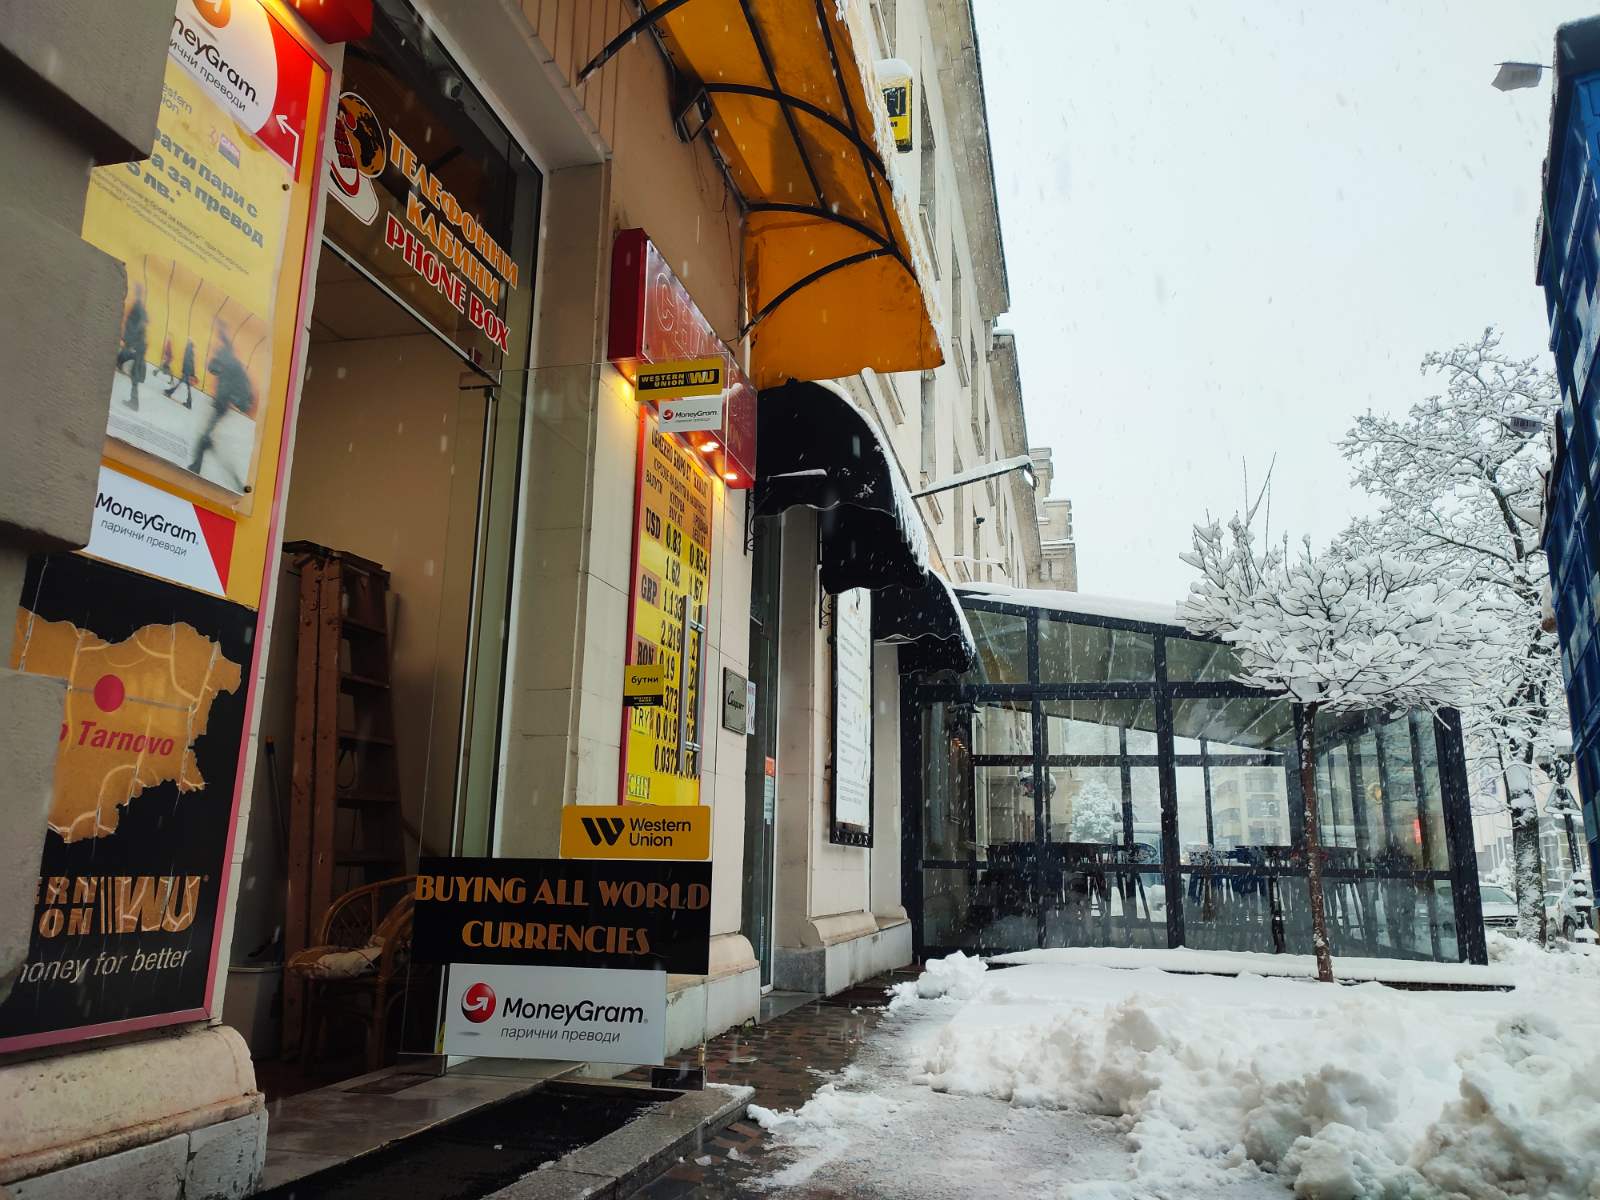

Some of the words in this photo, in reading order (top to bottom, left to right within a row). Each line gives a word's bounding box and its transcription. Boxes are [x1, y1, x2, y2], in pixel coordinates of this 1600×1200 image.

[170, 38, 198, 68] ични
[200, 67, 246, 112] преводи
[174, 16, 257, 102] neyGram
[161, 83, 192, 114] estern
[198, 164, 244, 208] пари
[168, 166, 191, 192] за
[195, 186, 263, 248] превод
[389, 129, 519, 289] ТЕЛЕФОННИ
[406, 190, 499, 306] КАБИНИ
[385, 212, 466, 314] PHONE
[469, 292, 511, 355] BOX
[641, 373, 684, 383] WESTERN
[654, 379, 684, 388] UNION
[675, 410, 717, 418] MoneyGram
[96, 493, 196, 544] MoneyGram
[646, 507, 661, 539] USD
[666, 523, 681, 557] 0.83
[101, 519, 144, 541] парични
[146, 535, 187, 556] преводи
[641, 573, 657, 605] GBP
[637, 641, 654, 665] RON
[631, 675, 659, 686] бутни
[632, 705, 649, 726] TRY
[78, 721, 175, 756] Tarnovo
[629, 833, 672, 847] Union
[630, 817, 691, 832] Western
[415, 875, 526, 904] BUYING
[532, 879, 589, 906] ALL
[599, 880, 709, 910] WORLD
[39, 908, 94, 938] ON
[461, 921, 650, 955] CURRENCIES
[93, 952, 128, 976] for
[131, 948, 192, 973] better
[502, 997, 644, 1026] MoneyGram
[501, 1026, 558, 1041] парични
[561, 1028, 620, 1043] преводи
